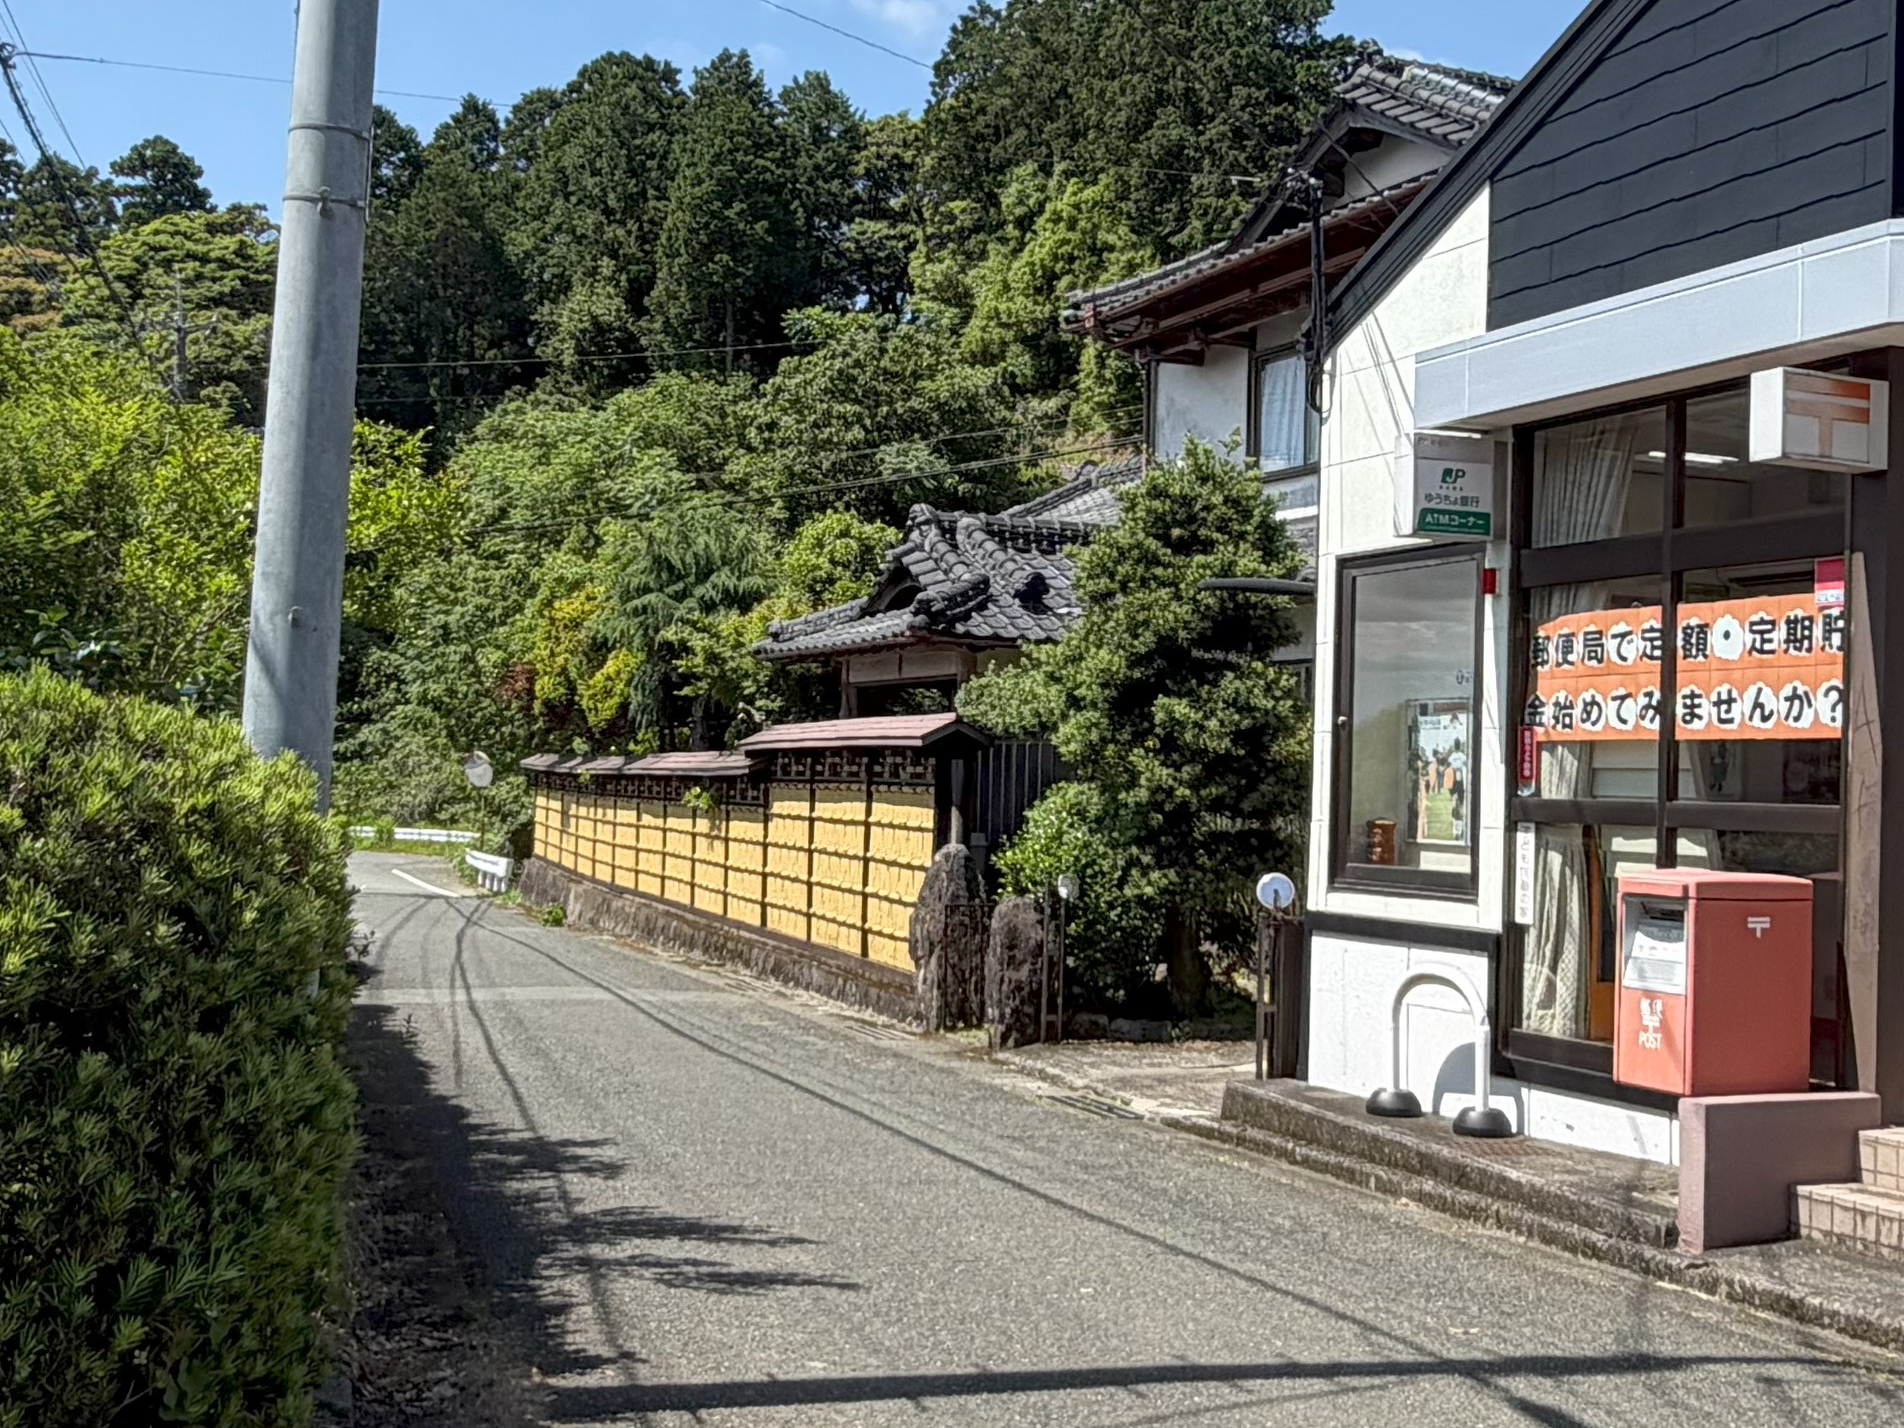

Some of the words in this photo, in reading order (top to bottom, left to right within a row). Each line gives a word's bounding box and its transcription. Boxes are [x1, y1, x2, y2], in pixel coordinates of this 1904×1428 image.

[1425, 493, 1480, 508] ゆうちょ銀行
[1425, 513, 1485, 527] ATMコーナー
[1638, 1031, 1663, 1049] POST
